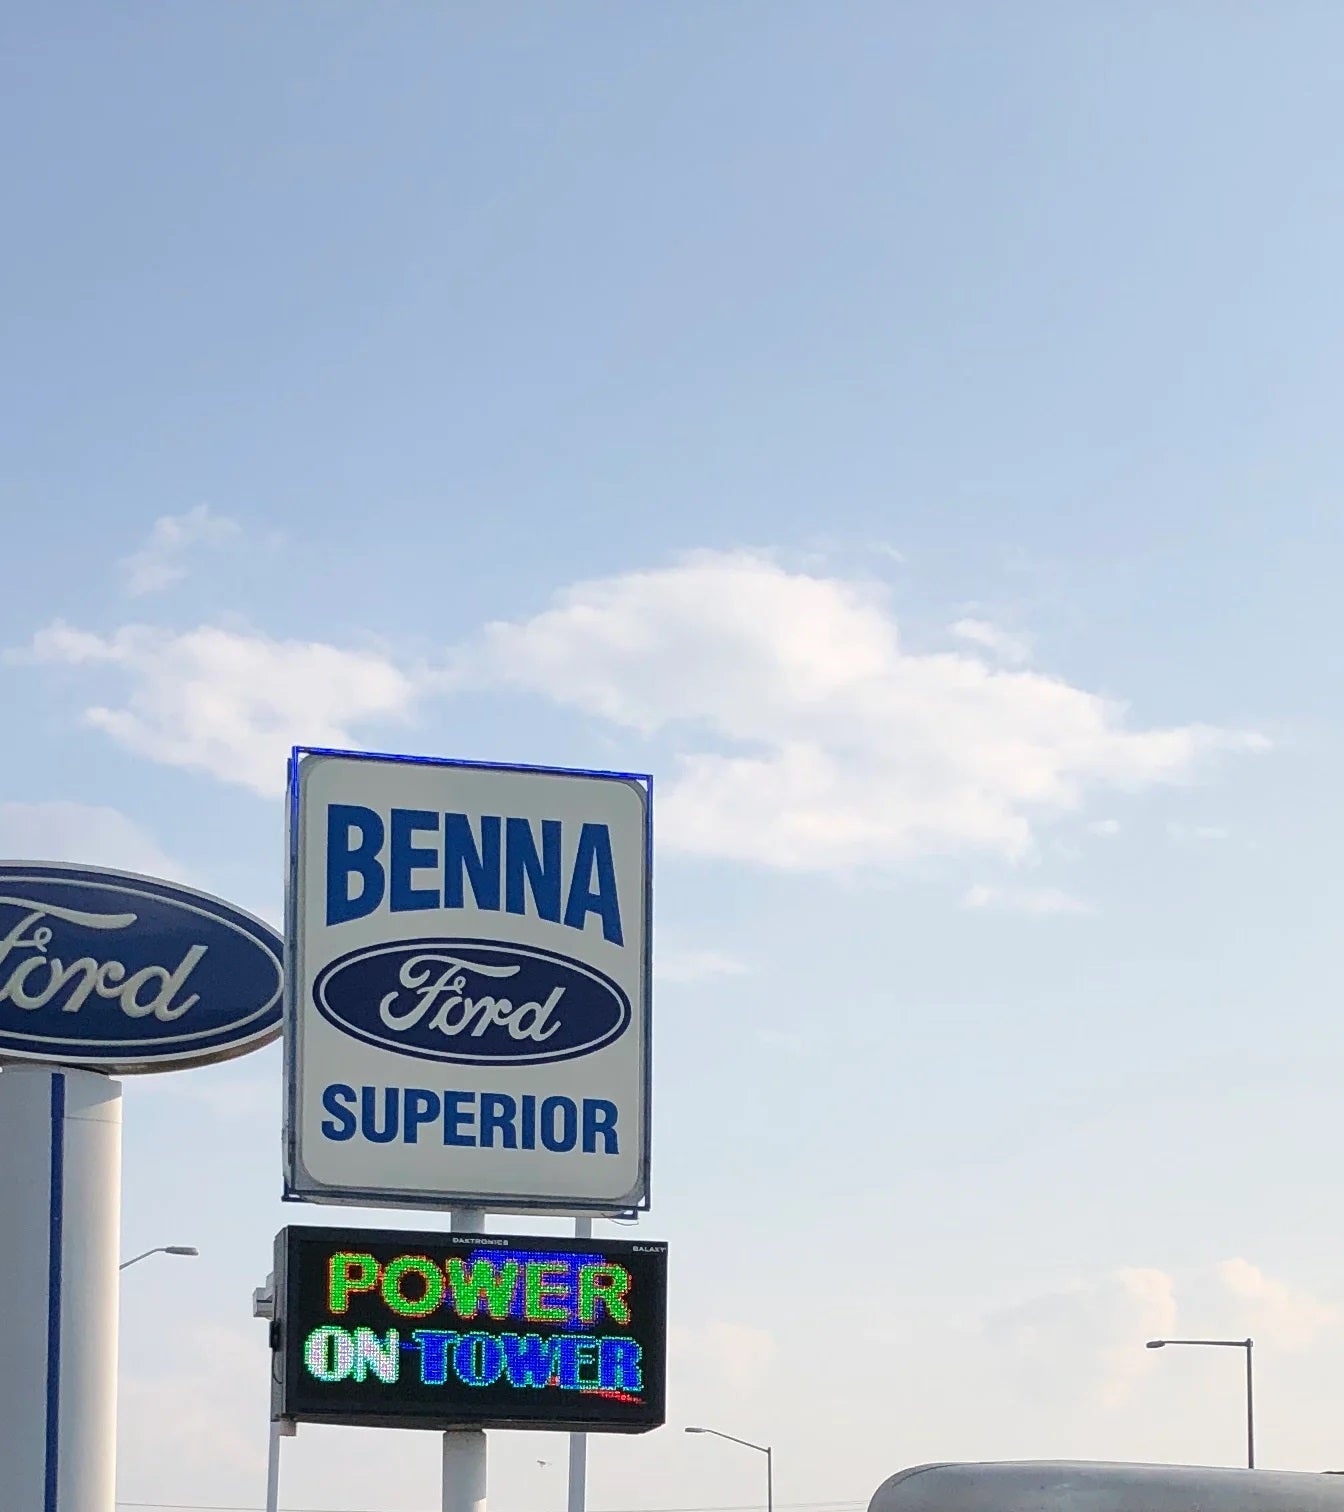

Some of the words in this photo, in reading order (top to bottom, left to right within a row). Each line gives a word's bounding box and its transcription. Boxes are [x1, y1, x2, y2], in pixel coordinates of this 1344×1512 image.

[326, 804, 624, 947] BENNA
[379, 954, 566, 1041] Ford
[321, 1083, 619, 1154] SUPERIOR
[327, 1251, 633, 1325] POWER
[304, 1325, 400, 1383] ON
[411, 1329, 643, 1391] TOWER
